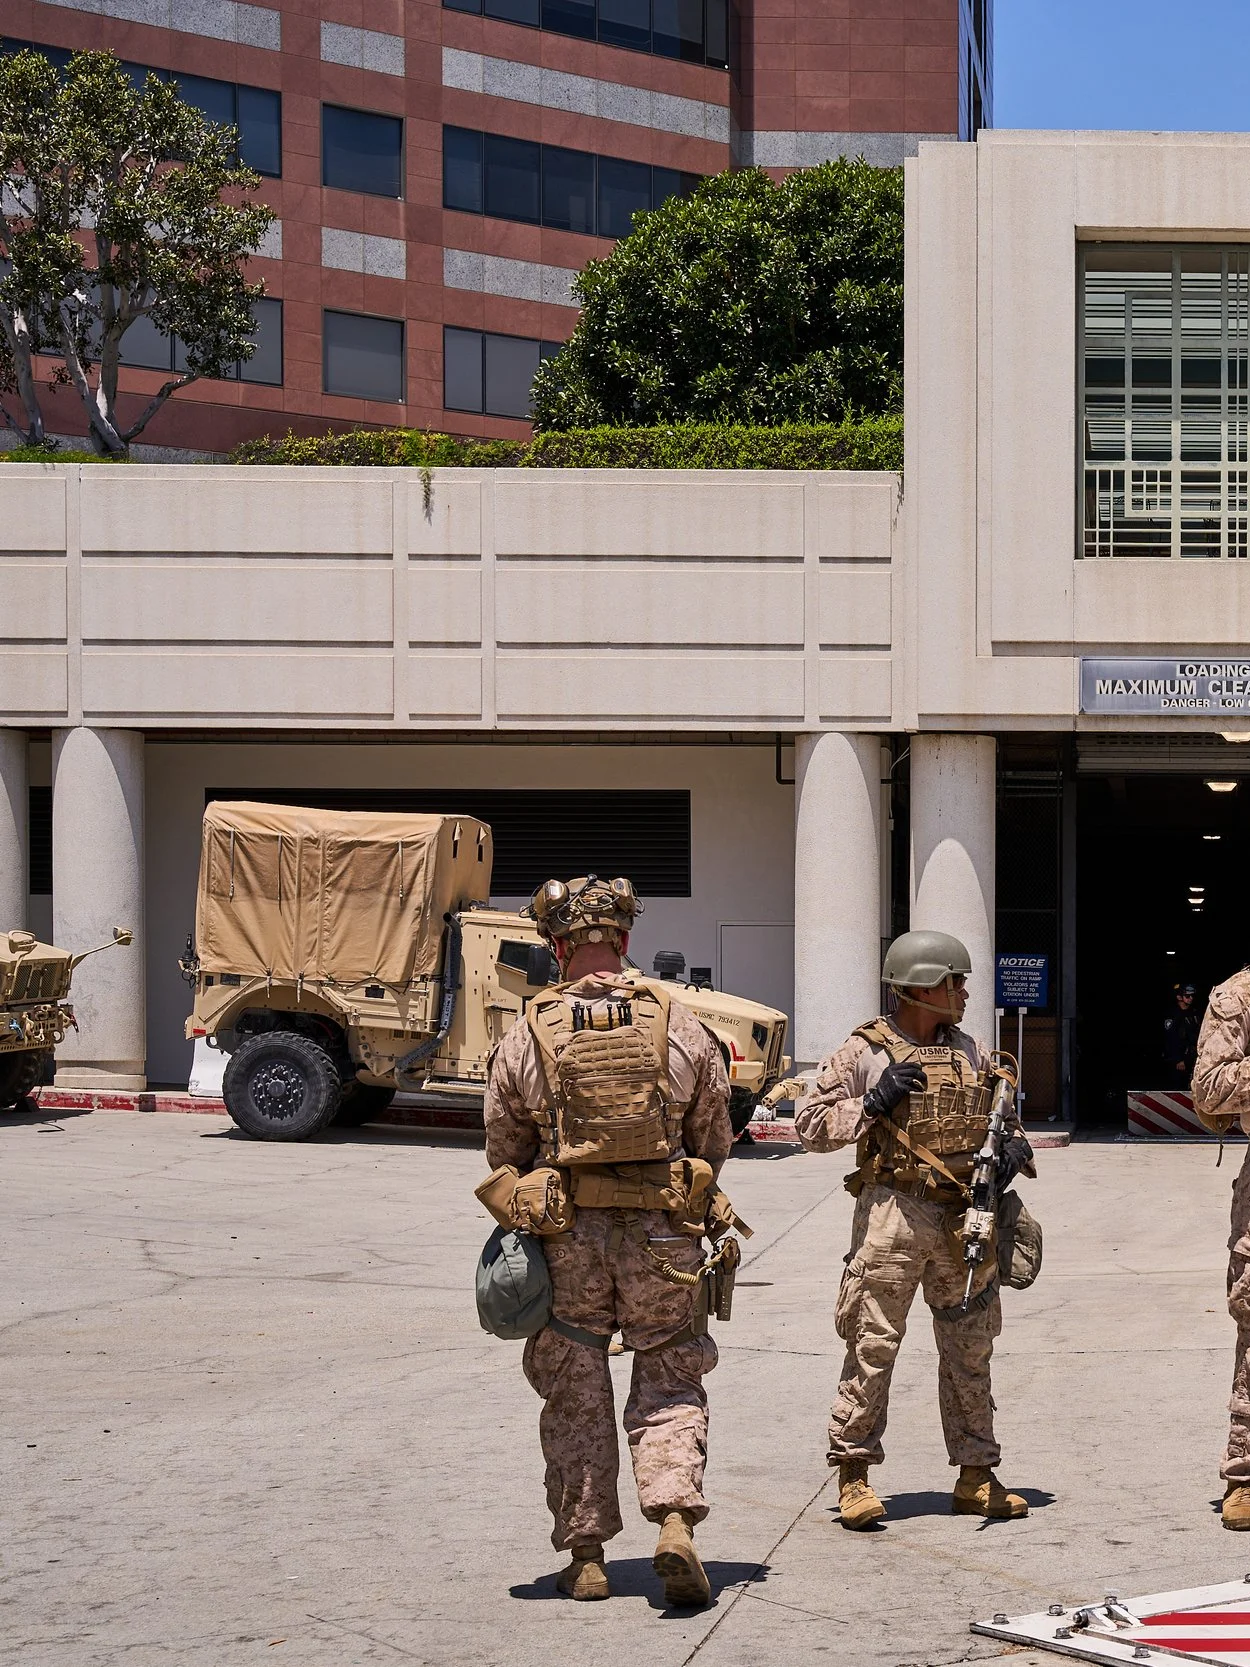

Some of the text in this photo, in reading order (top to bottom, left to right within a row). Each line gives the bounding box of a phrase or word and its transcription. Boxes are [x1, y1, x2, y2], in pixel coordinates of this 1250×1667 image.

[1176, 664, 1250, 678] LOADING
[1096, 679, 1197, 696] MAXIMUM
[1161, 698, 1210, 708] DANGER
[1219, 698, 1245, 709] LOW
[1000, 958, 1046, 966] NOTICE
[698, 1011, 741, 1026] USMC 793412
[920, 1047, 949, 1055] USMC
